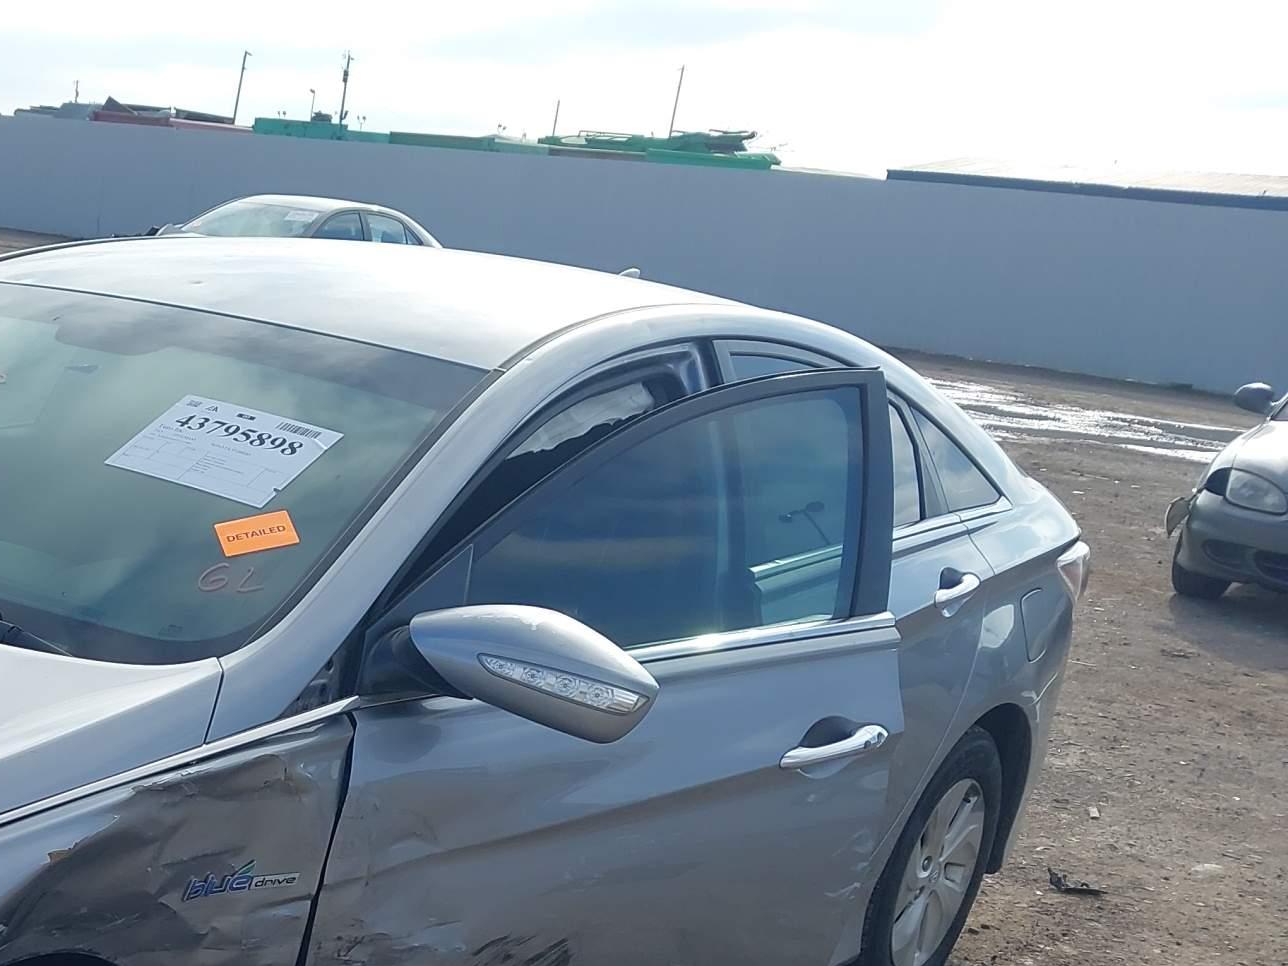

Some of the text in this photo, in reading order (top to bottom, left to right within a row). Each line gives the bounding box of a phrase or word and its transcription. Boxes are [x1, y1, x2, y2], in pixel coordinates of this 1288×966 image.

[175, 414, 304, 456] 43795898
[226, 524, 286, 543] DETAILED
[254, 876, 296, 888] drive
